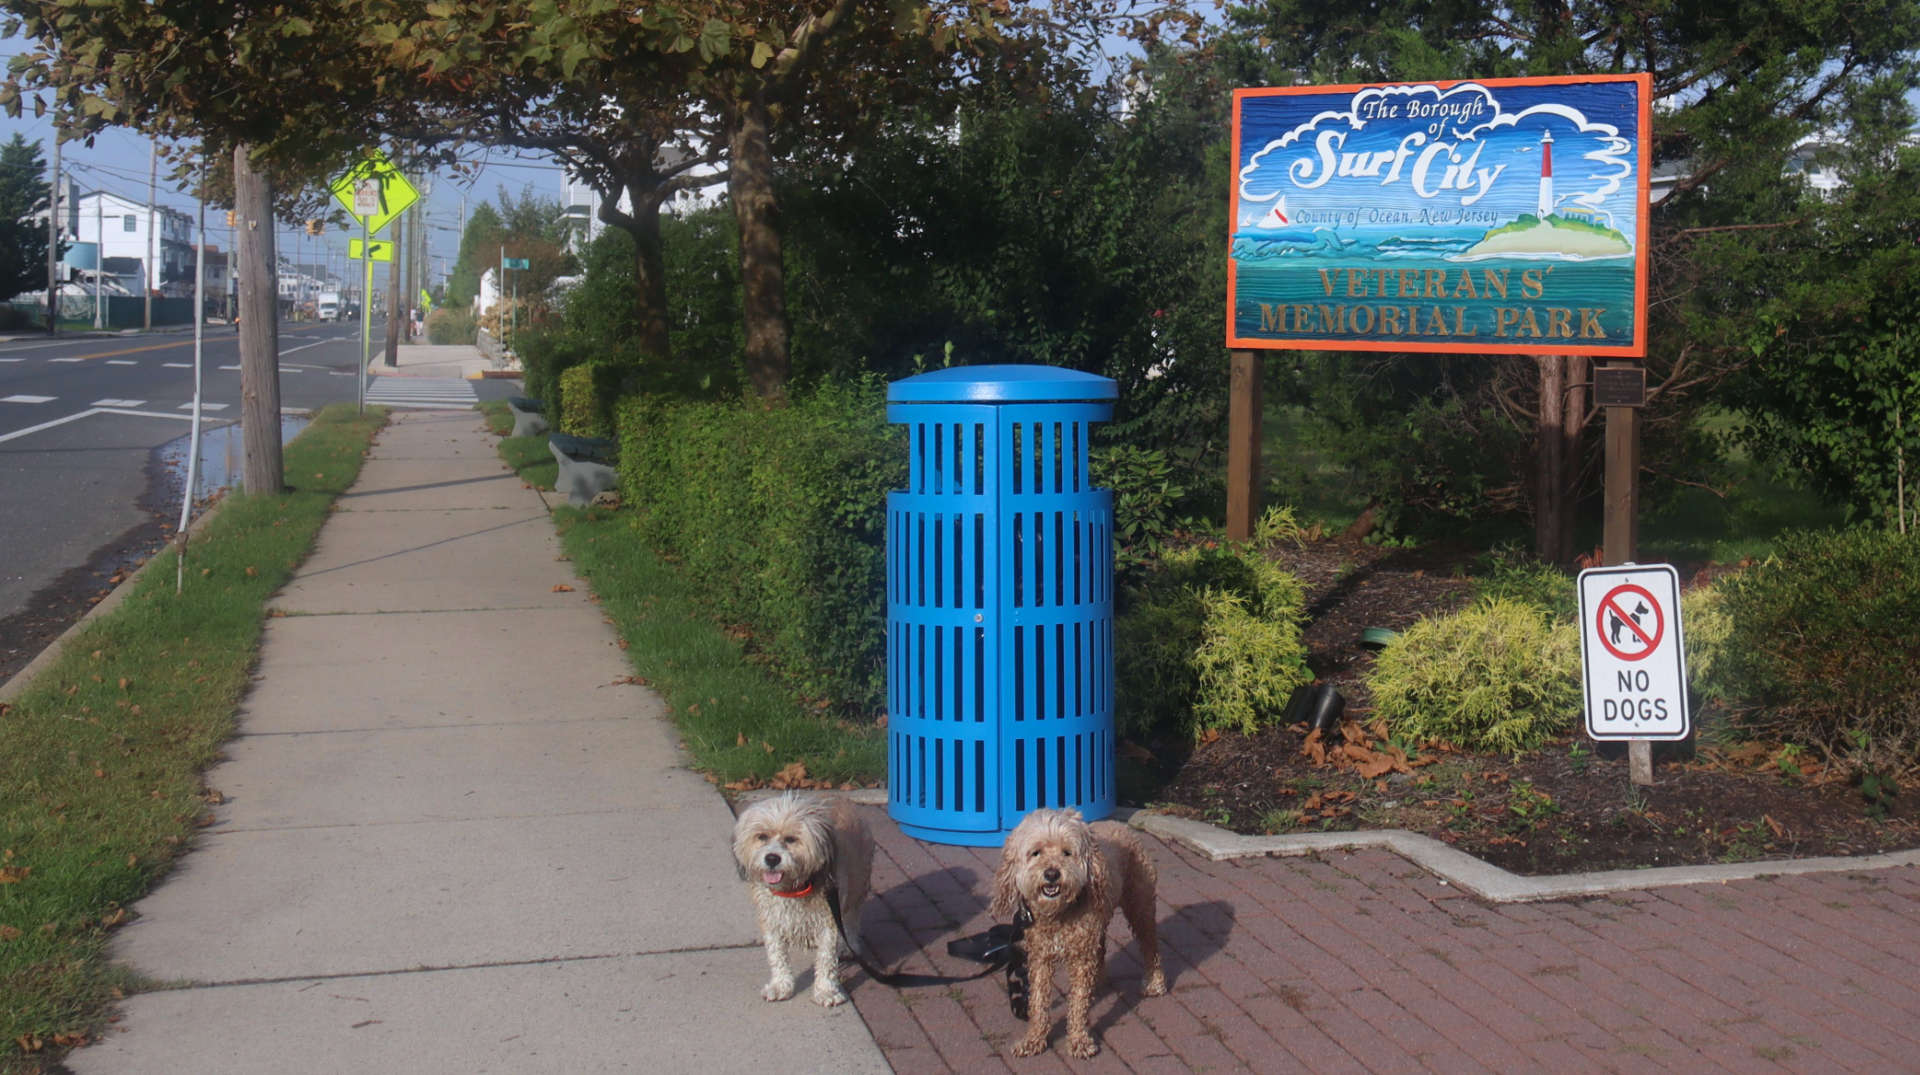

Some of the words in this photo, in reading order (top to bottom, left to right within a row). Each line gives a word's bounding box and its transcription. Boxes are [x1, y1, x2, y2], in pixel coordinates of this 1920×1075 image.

[1363, 98, 1398, 119] The
[1406, 95, 1483, 124] Borough
[1428, 117, 1448, 141] of
[1289, 130, 1426, 189] Surf
[1411, 139, 1508, 206] City
[1296, 209, 1341, 229] County
[1349, 207, 1363, 229] of
[1369, 208, 1413, 225] Ocean,
[1420, 207, 1450, 226] New
[1455, 208, 1499, 229] Jersey
[1259, 303, 1478, 336] MEMORIAL
[1494, 307, 1608, 339] PARK
[1617, 669, 1650, 692] NO
[1603, 698, 1669, 722] DOGS
